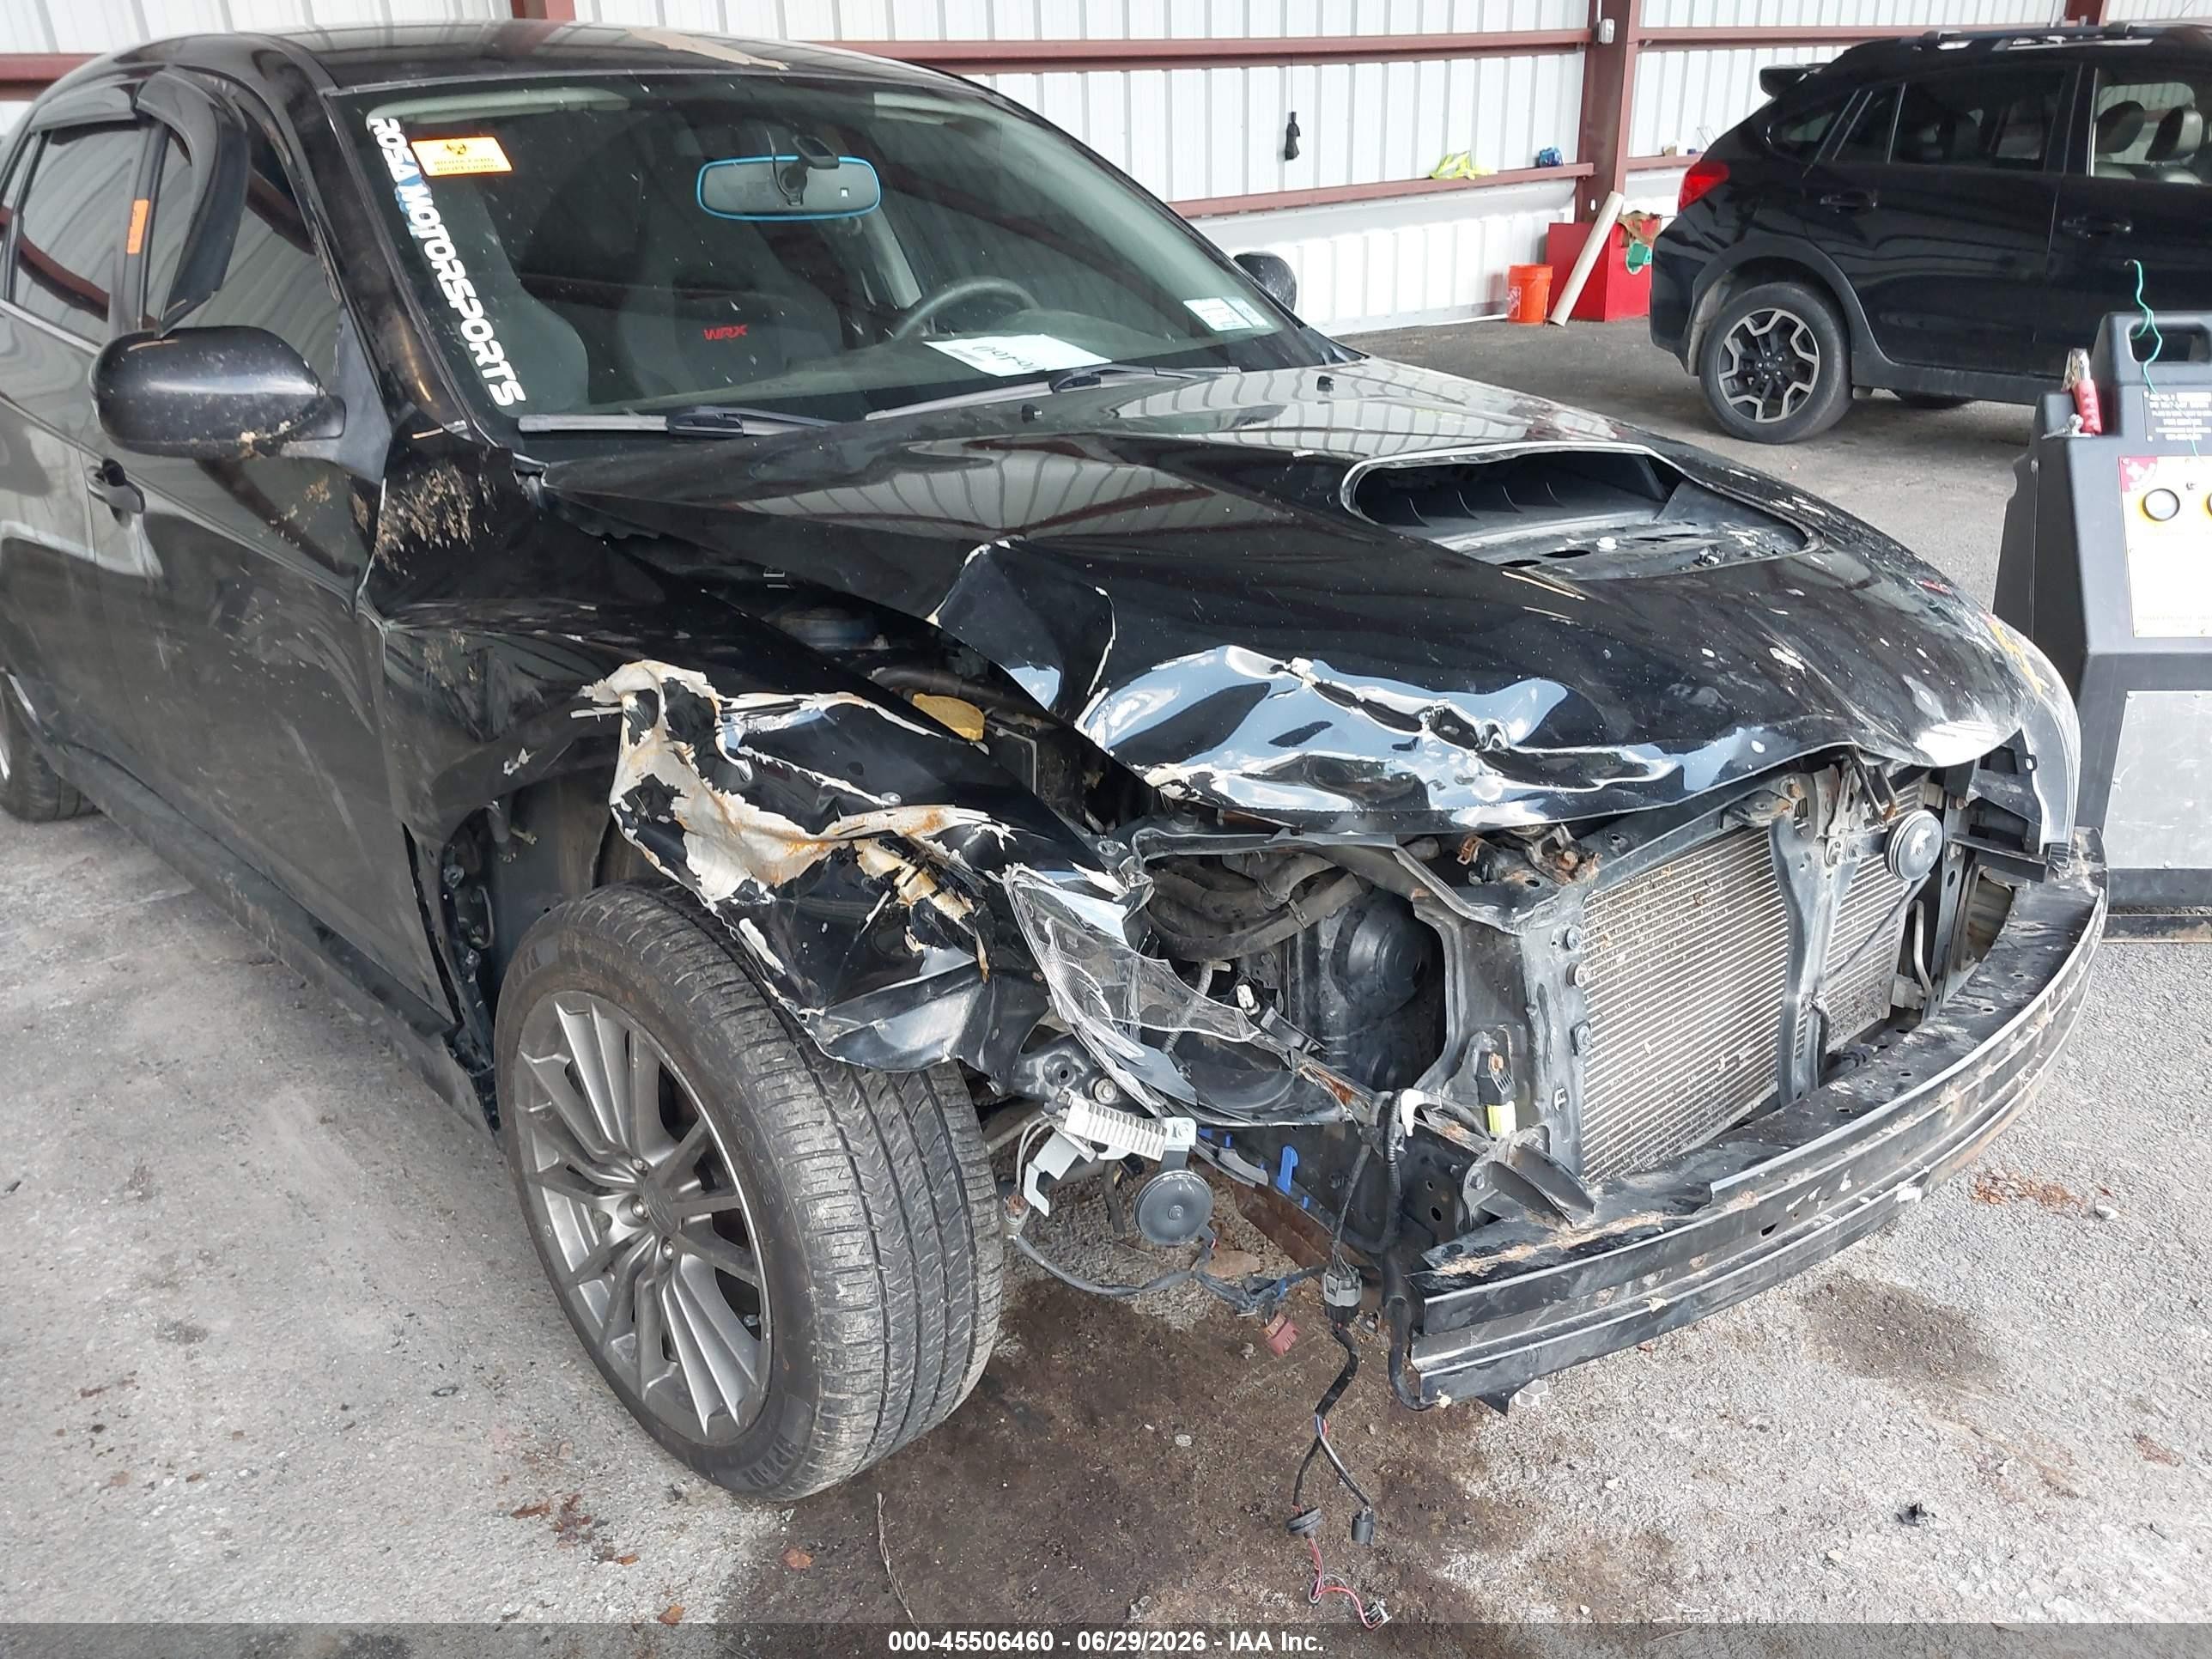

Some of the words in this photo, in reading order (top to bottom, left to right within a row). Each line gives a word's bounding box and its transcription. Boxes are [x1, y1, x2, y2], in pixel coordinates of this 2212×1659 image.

[369, 118, 421, 182] ROSA
[398, 183, 526, 406] MOTORSPORTS
[703, 324, 747, 340] WRX
